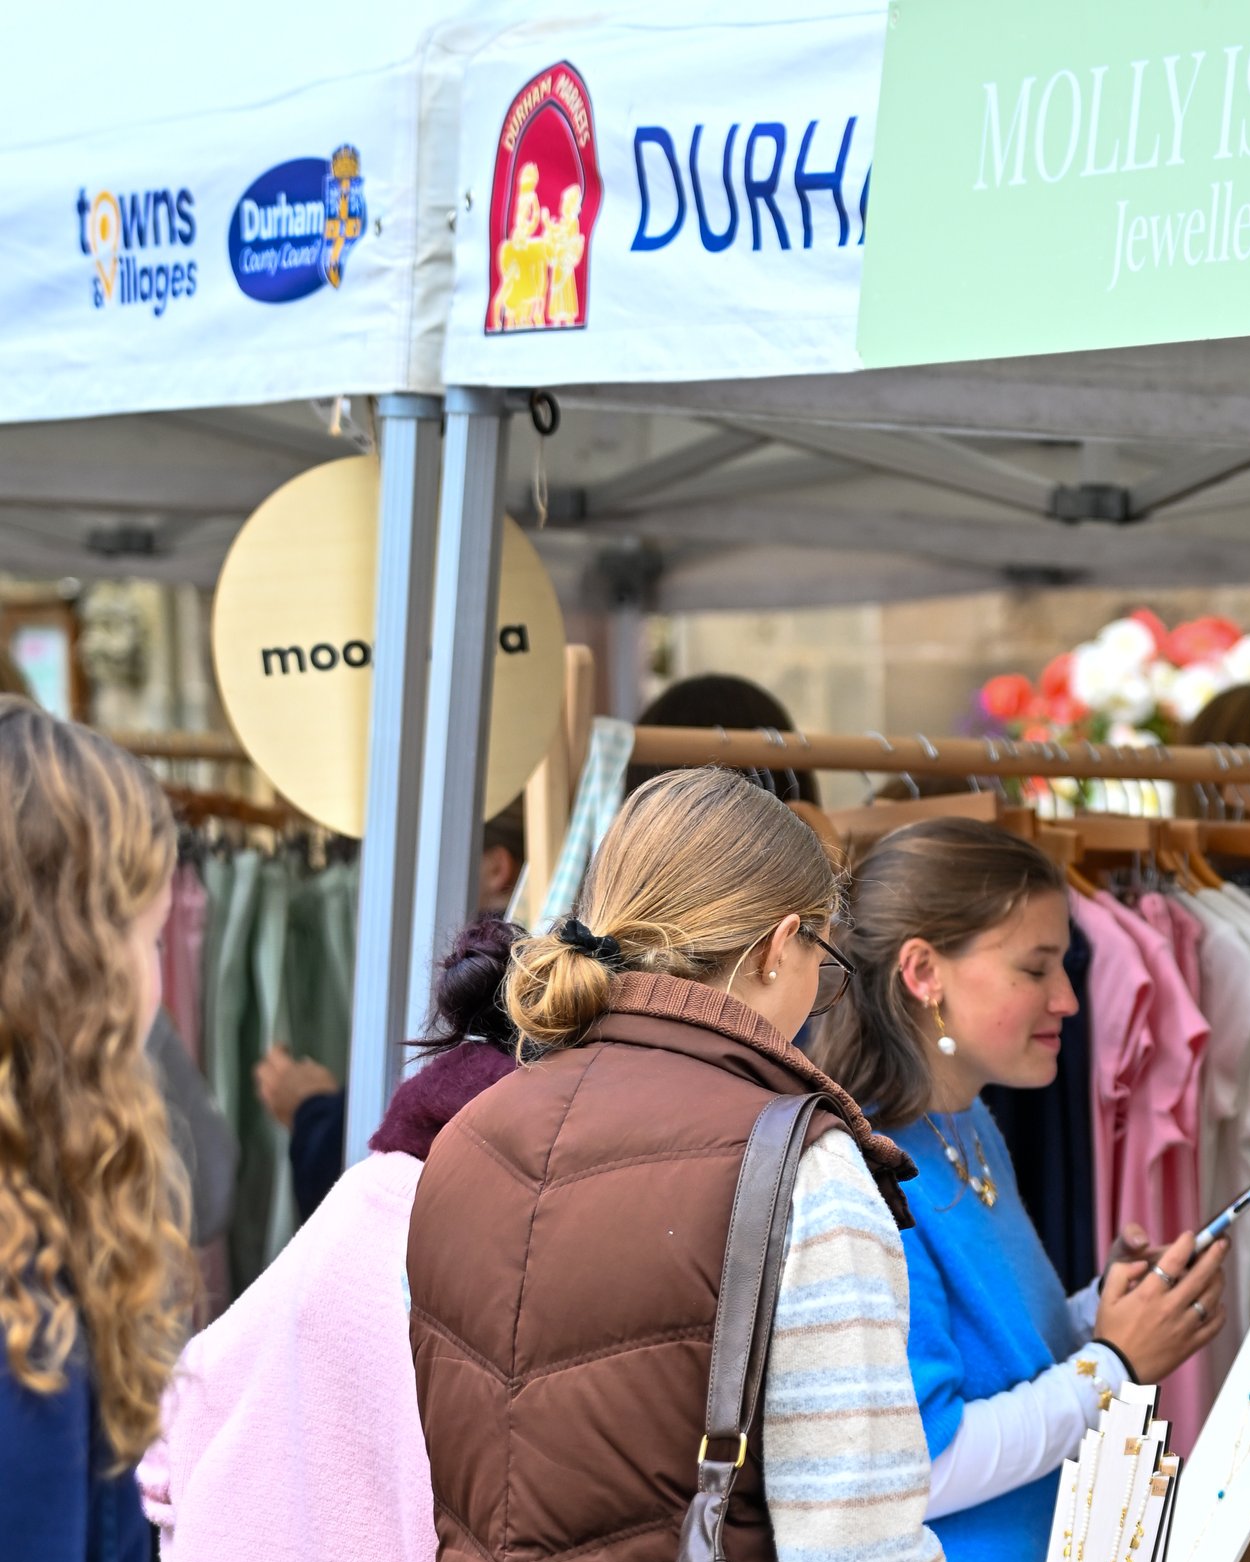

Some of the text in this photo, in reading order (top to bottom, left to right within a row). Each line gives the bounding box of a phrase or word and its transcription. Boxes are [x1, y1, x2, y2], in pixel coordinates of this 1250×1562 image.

[503, 75, 552, 152] DURHAM
[973, 52, 1206, 191] MOLLY
[240, 192, 325, 243] Durham
[630, 116, 872, 253] DURH
[76, 187, 196, 255] towns
[239, 246, 279, 277] County
